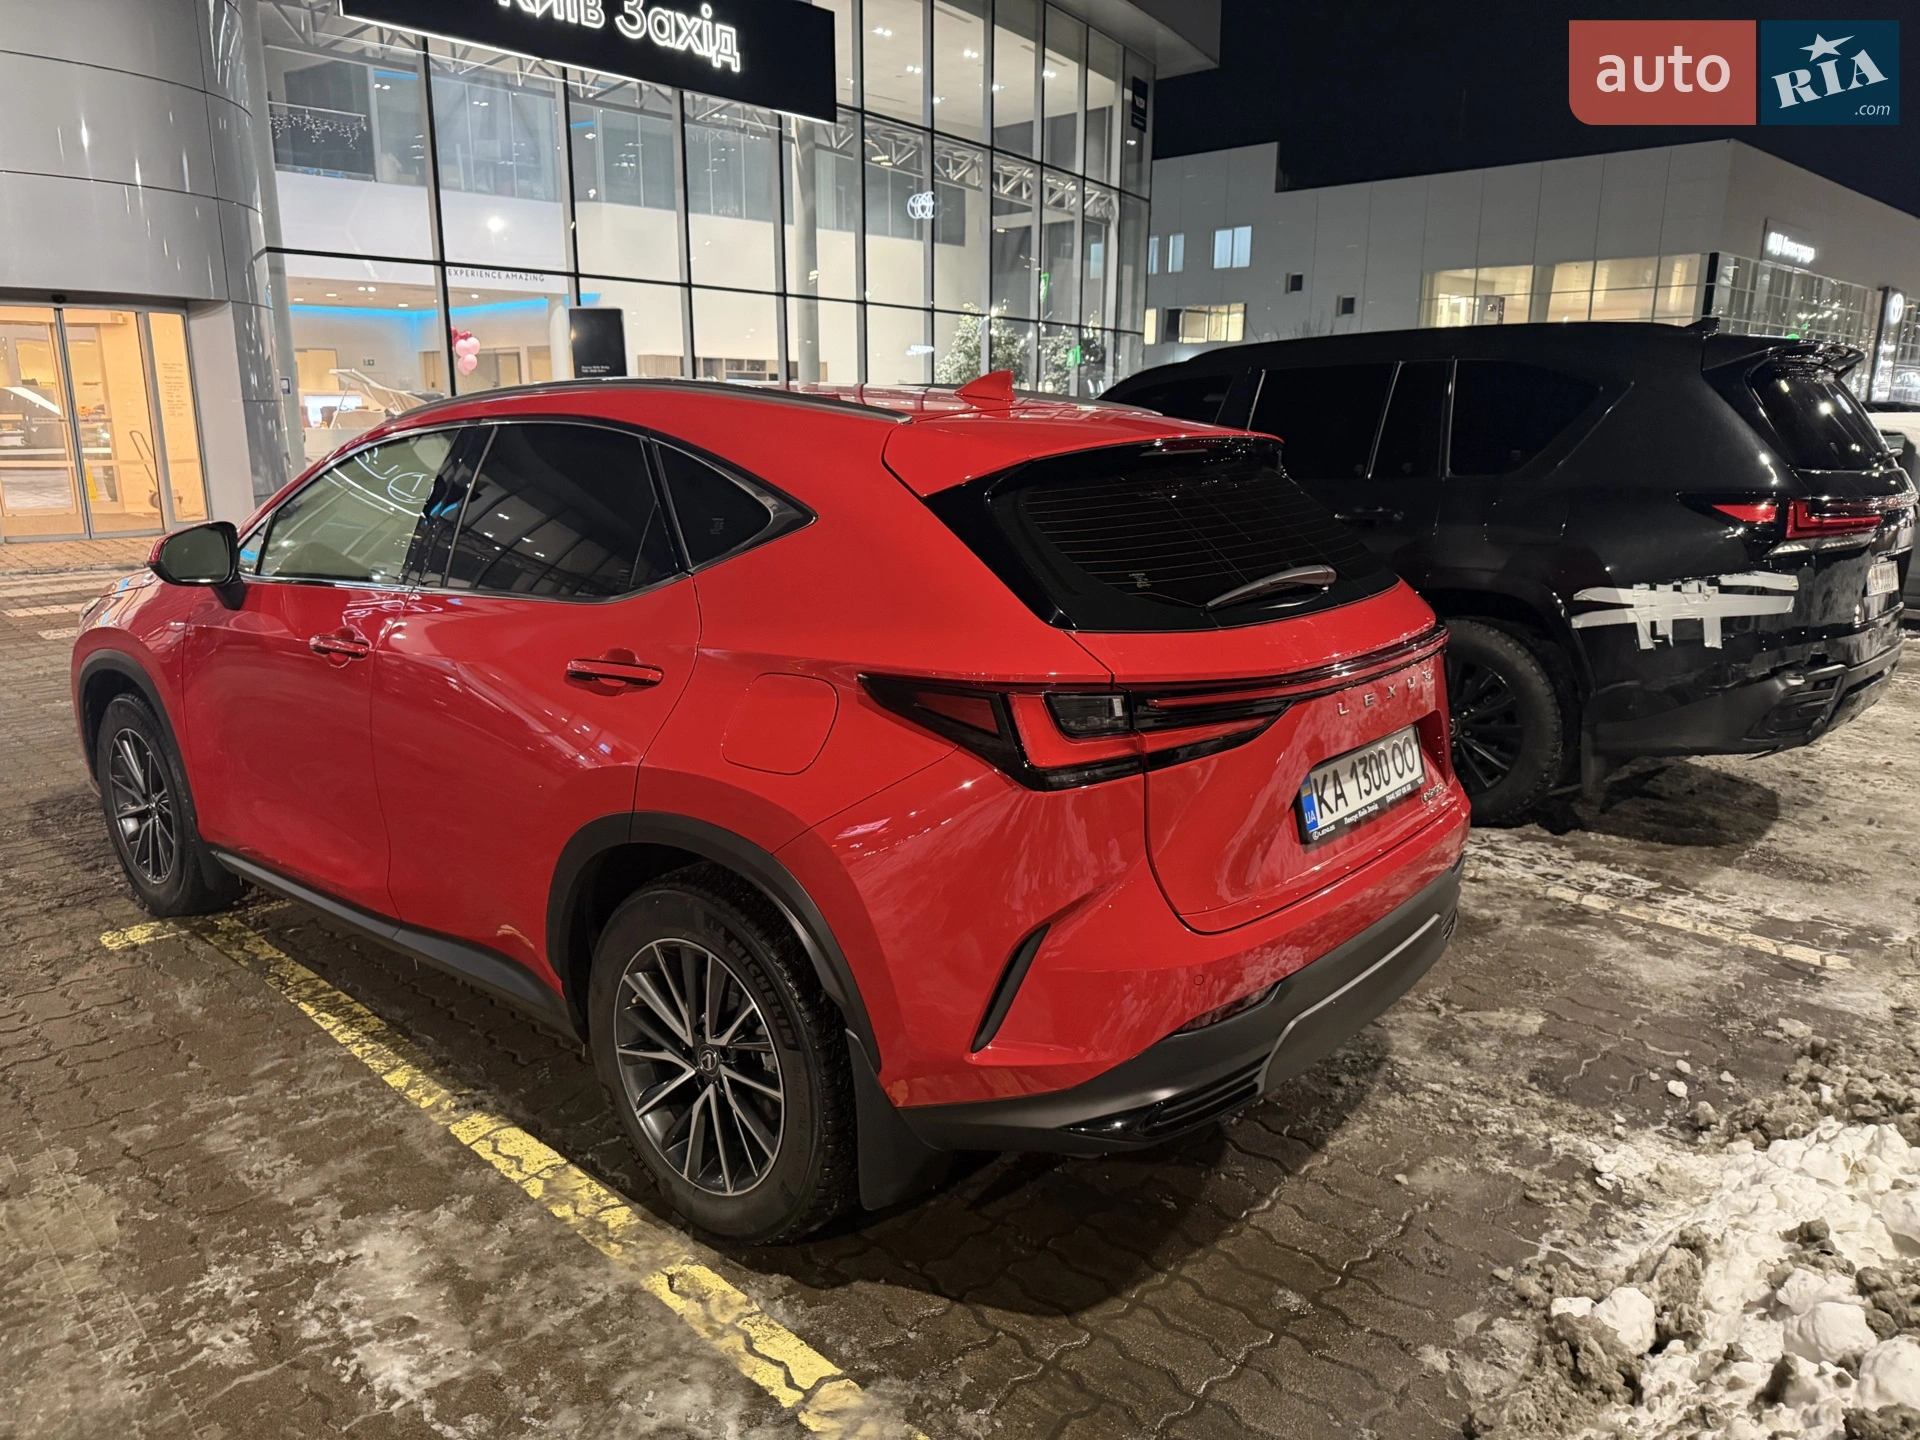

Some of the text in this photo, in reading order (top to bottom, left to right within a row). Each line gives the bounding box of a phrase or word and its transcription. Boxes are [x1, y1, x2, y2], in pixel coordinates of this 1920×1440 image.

[614, 0, 740, 73] Захід
[448, 268, 545, 283] EXPERIENCE AMAZING
[1337, 668, 1433, 716] LEXUS
[1313, 769, 1349, 820] KA
[1350, 747, 1391, 800] 1300
[1305, 809, 1317, 824] UA
[727, 939, 797, 1046] MICHELIN
